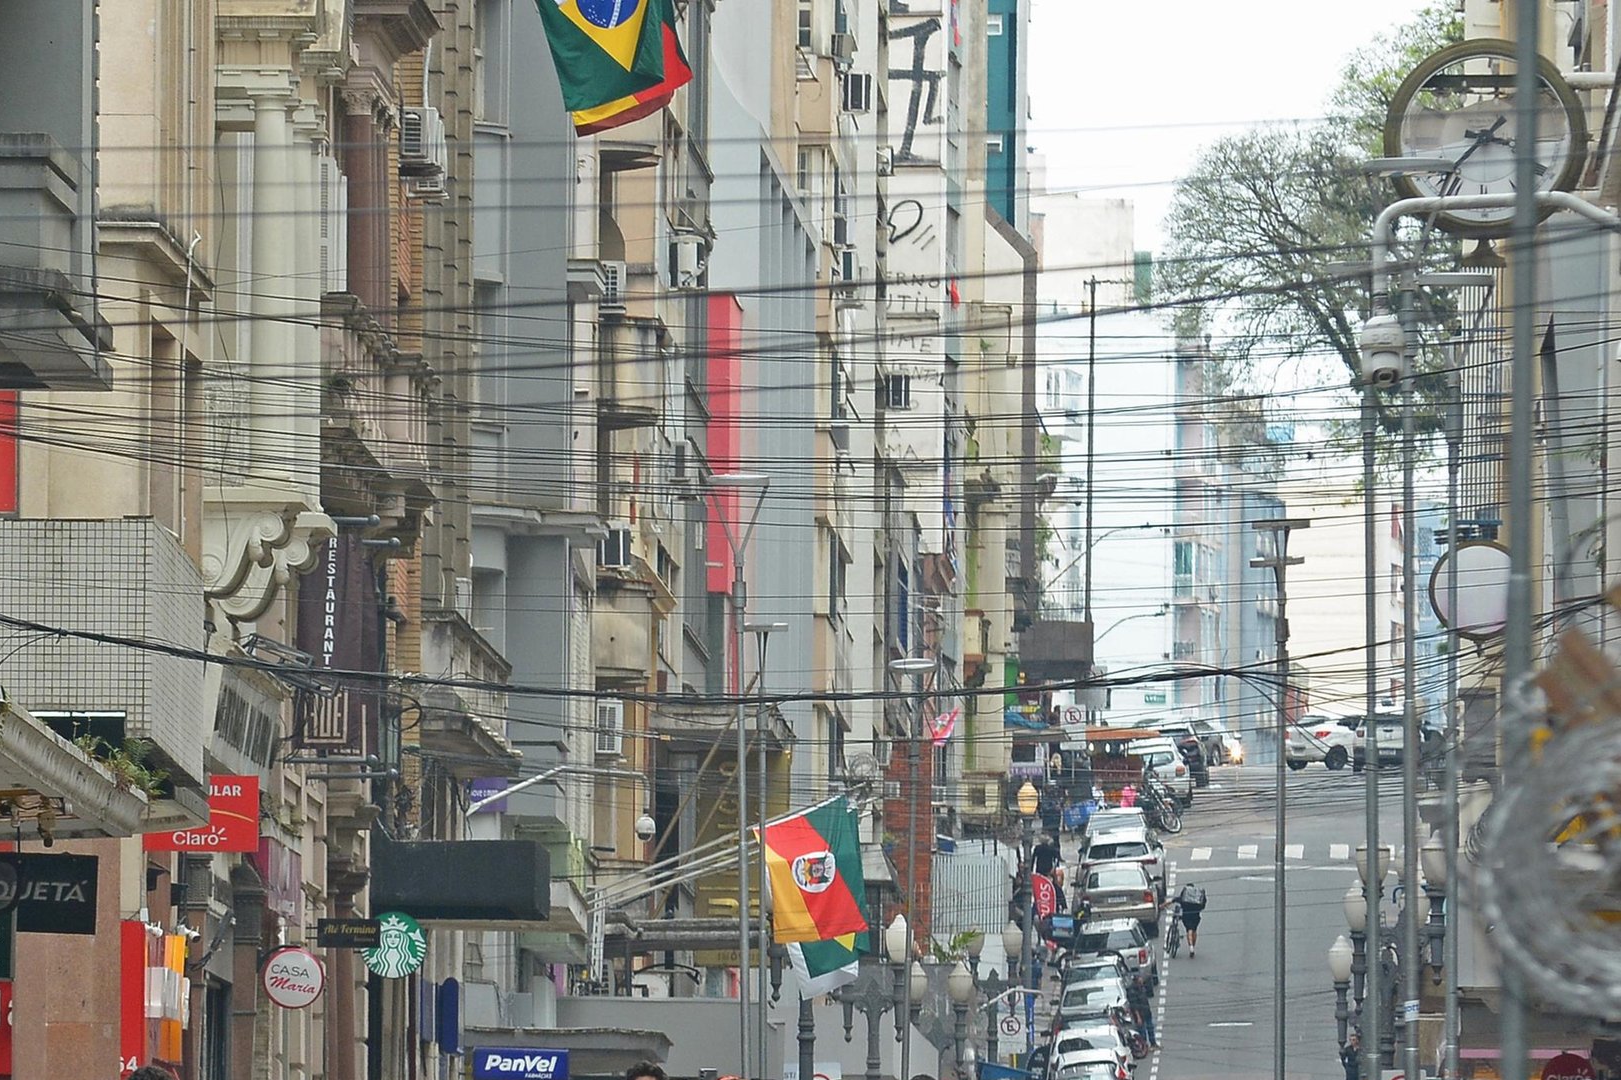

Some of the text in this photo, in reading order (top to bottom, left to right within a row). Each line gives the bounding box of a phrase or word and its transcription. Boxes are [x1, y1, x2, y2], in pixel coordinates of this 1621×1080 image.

[323, 537, 337, 671] RESTAURANT
[172, 829, 223, 846] Claro
[271, 964, 310, 978] CASA
[270, 976, 316, 994] Maria
[485, 1054, 558, 1072] PanVel
